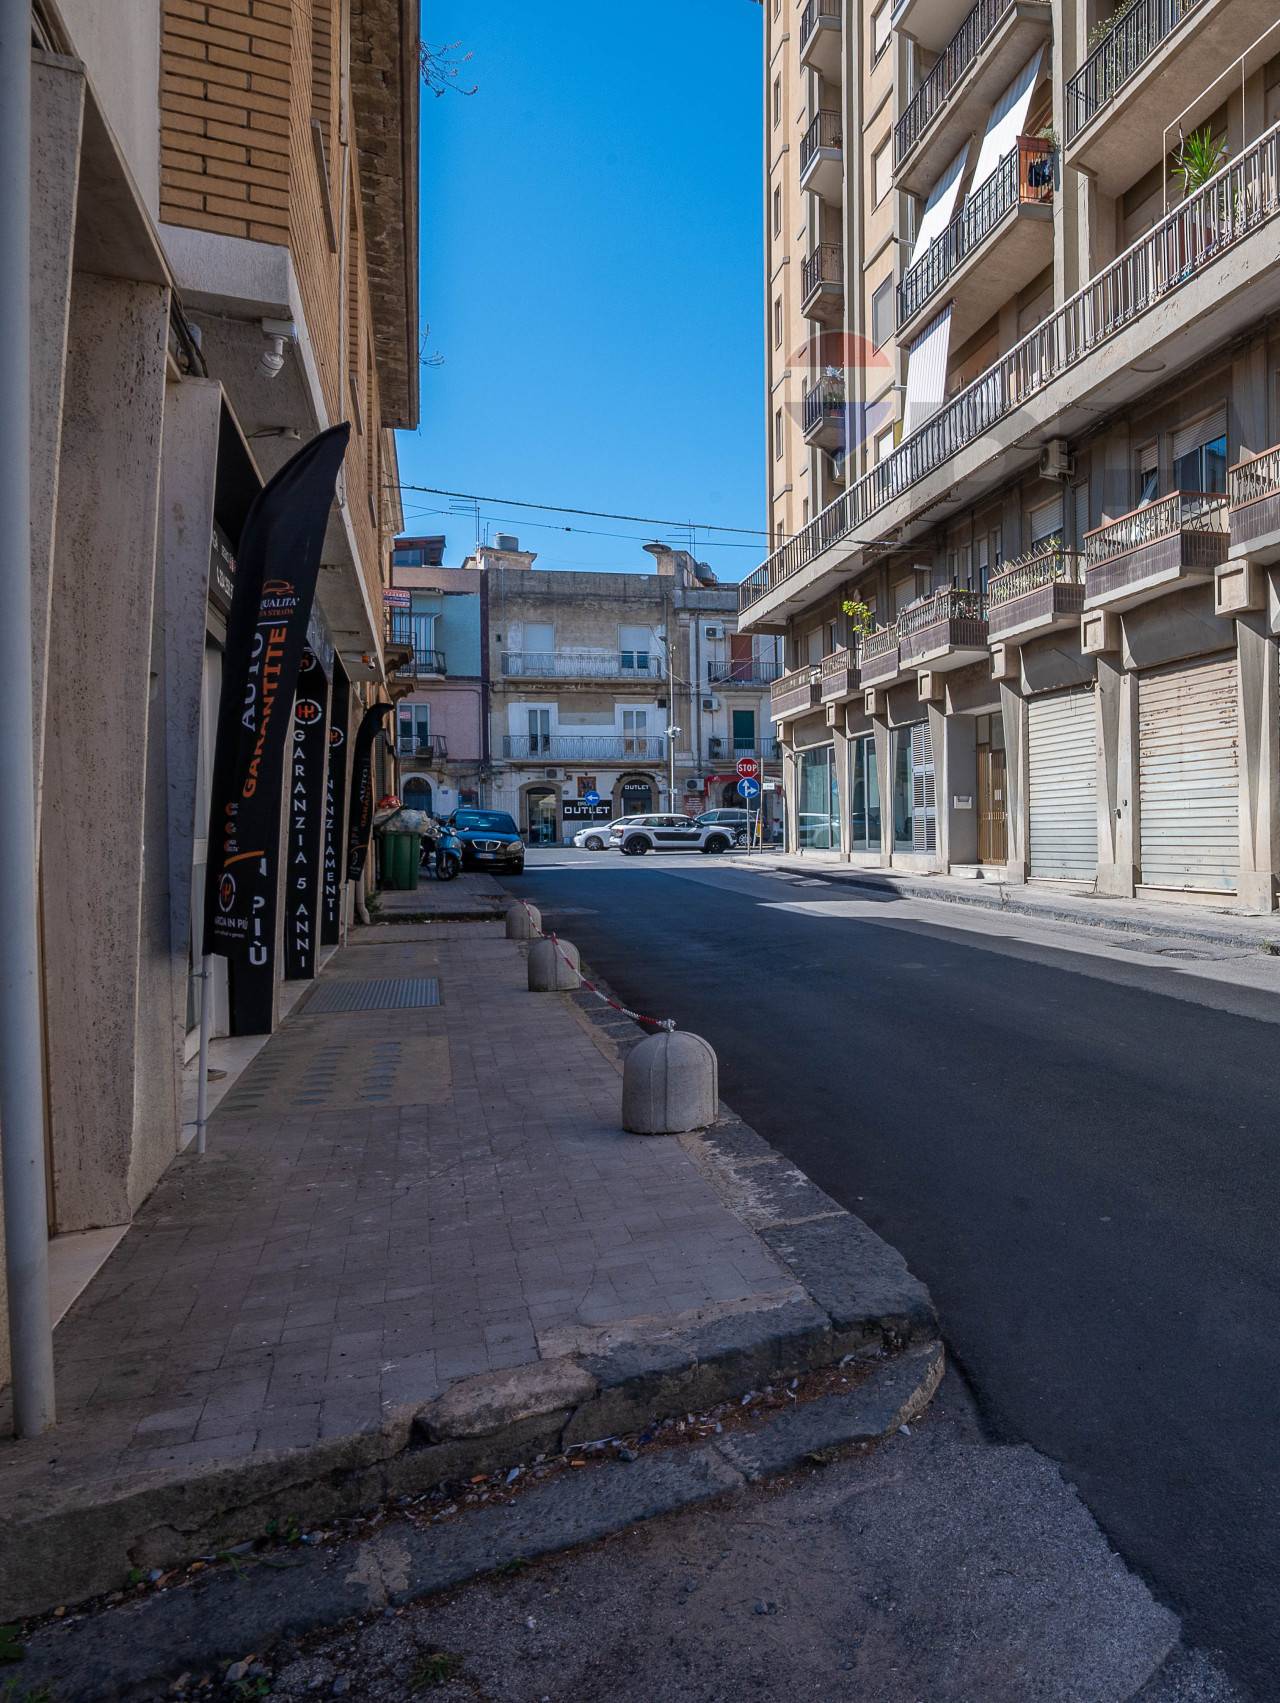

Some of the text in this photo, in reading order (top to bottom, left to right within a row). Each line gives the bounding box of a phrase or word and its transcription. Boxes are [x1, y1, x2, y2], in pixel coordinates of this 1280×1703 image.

[738, 764, 757, 772] STOP
[564, 806, 611, 814] OUTLET
[292, 729, 309, 968] GARANZIA 5 ANNI
